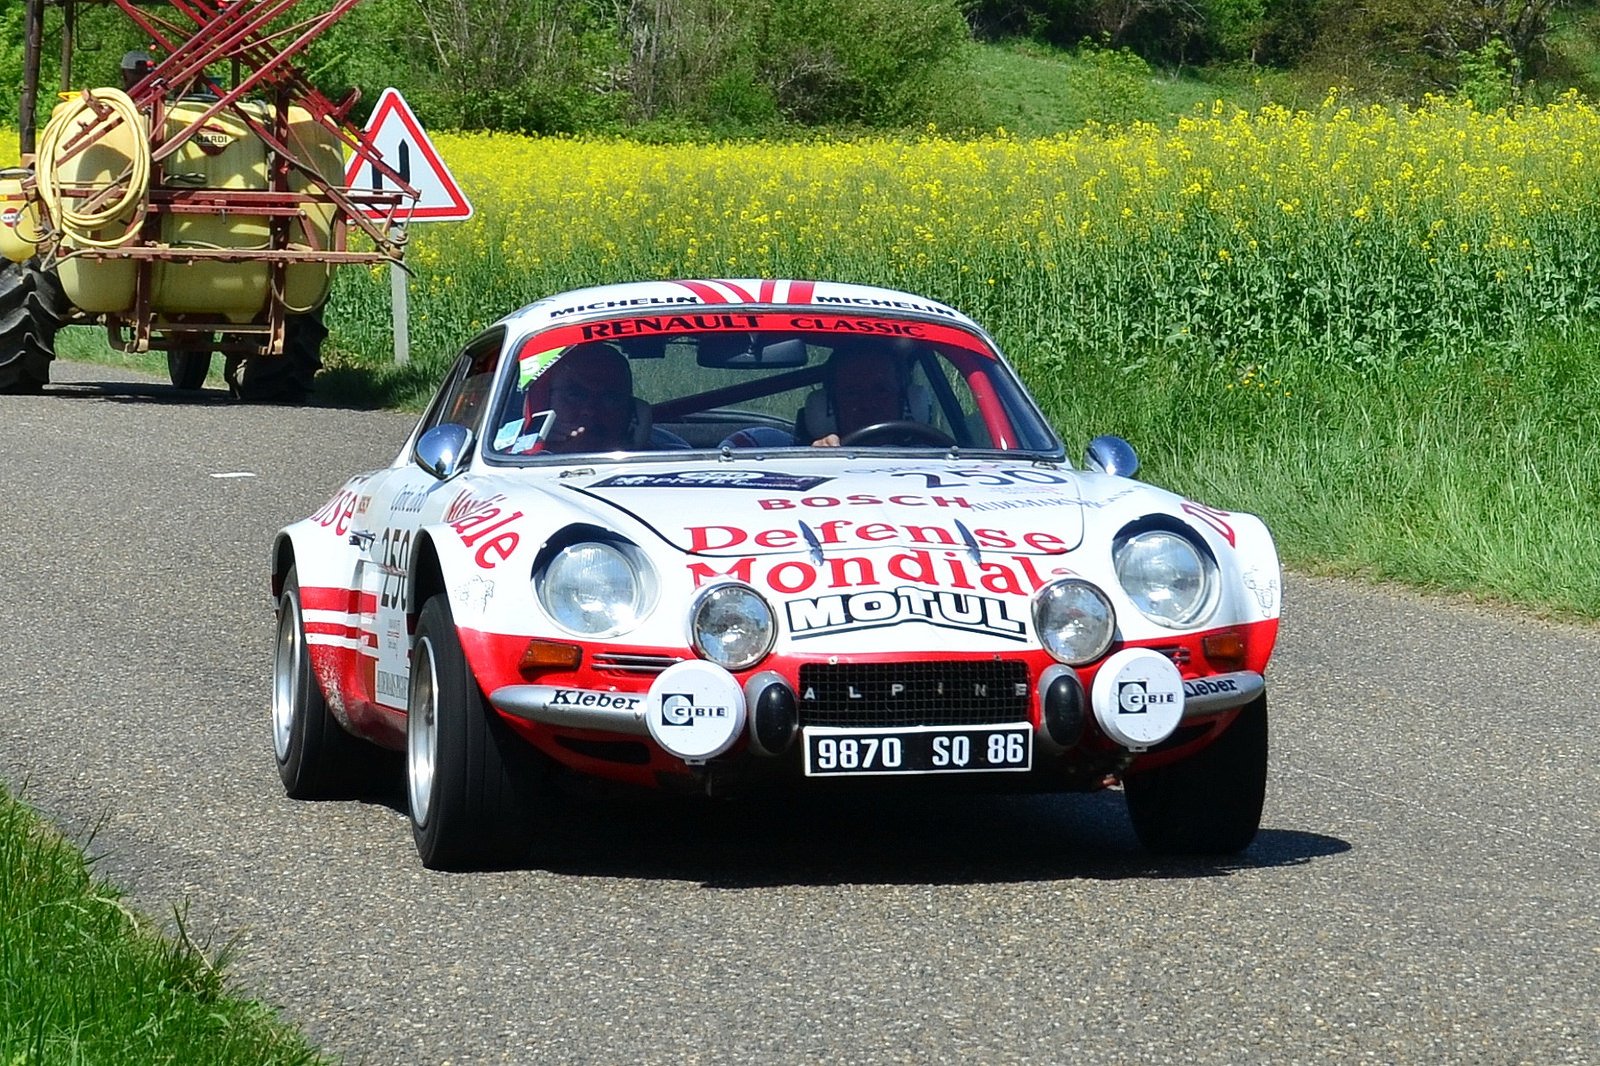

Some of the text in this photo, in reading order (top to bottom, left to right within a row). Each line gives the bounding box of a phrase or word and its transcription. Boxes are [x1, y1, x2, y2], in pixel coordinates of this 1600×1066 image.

[196, 135, 228, 143] HARDI
[550, 296, 698, 318] MICHELIN
[816, 296, 956, 317] MICHELIN
[582, 314, 926, 340] RENAULT CLASSIC
[891, 470, 1068, 489] 250
[758, 494, 971, 510] BOSCH
[684, 520, 1067, 555] Defense
[686, 549, 1080, 596] Mondial
[785, 586, 1027, 635] MOTUL
[550, 689, 640, 711] Kleber
[818, 733, 1025, 769] 9870 SQ 86
